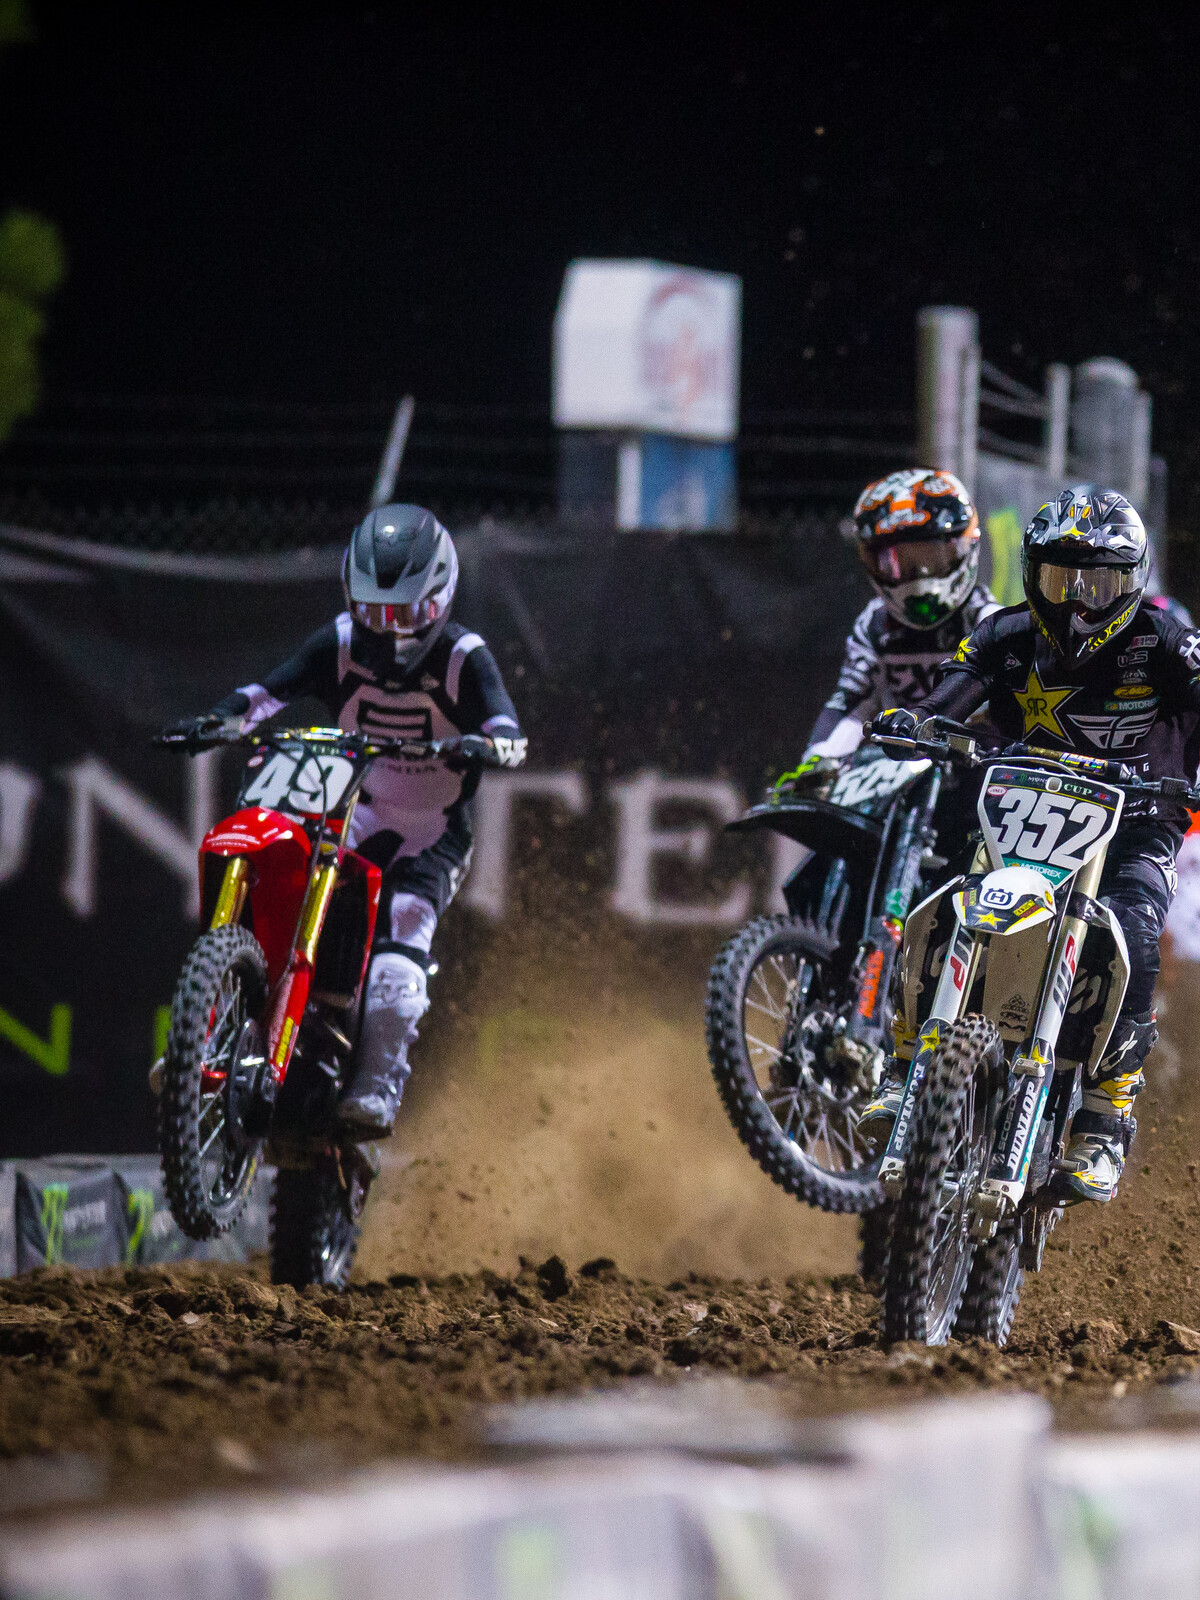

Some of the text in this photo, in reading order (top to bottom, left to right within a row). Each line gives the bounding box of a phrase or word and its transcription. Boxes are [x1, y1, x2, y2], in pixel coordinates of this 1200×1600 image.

[1119, 699, 1157, 710] MOTORE
[244, 752, 354, 814] 49
[1063, 783, 1093, 796] CUP
[991, 787, 1108, 871] 352
[895, 1062, 925, 1151] DUNLOP
[1007, 1081, 1036, 1171] DUNLOP
